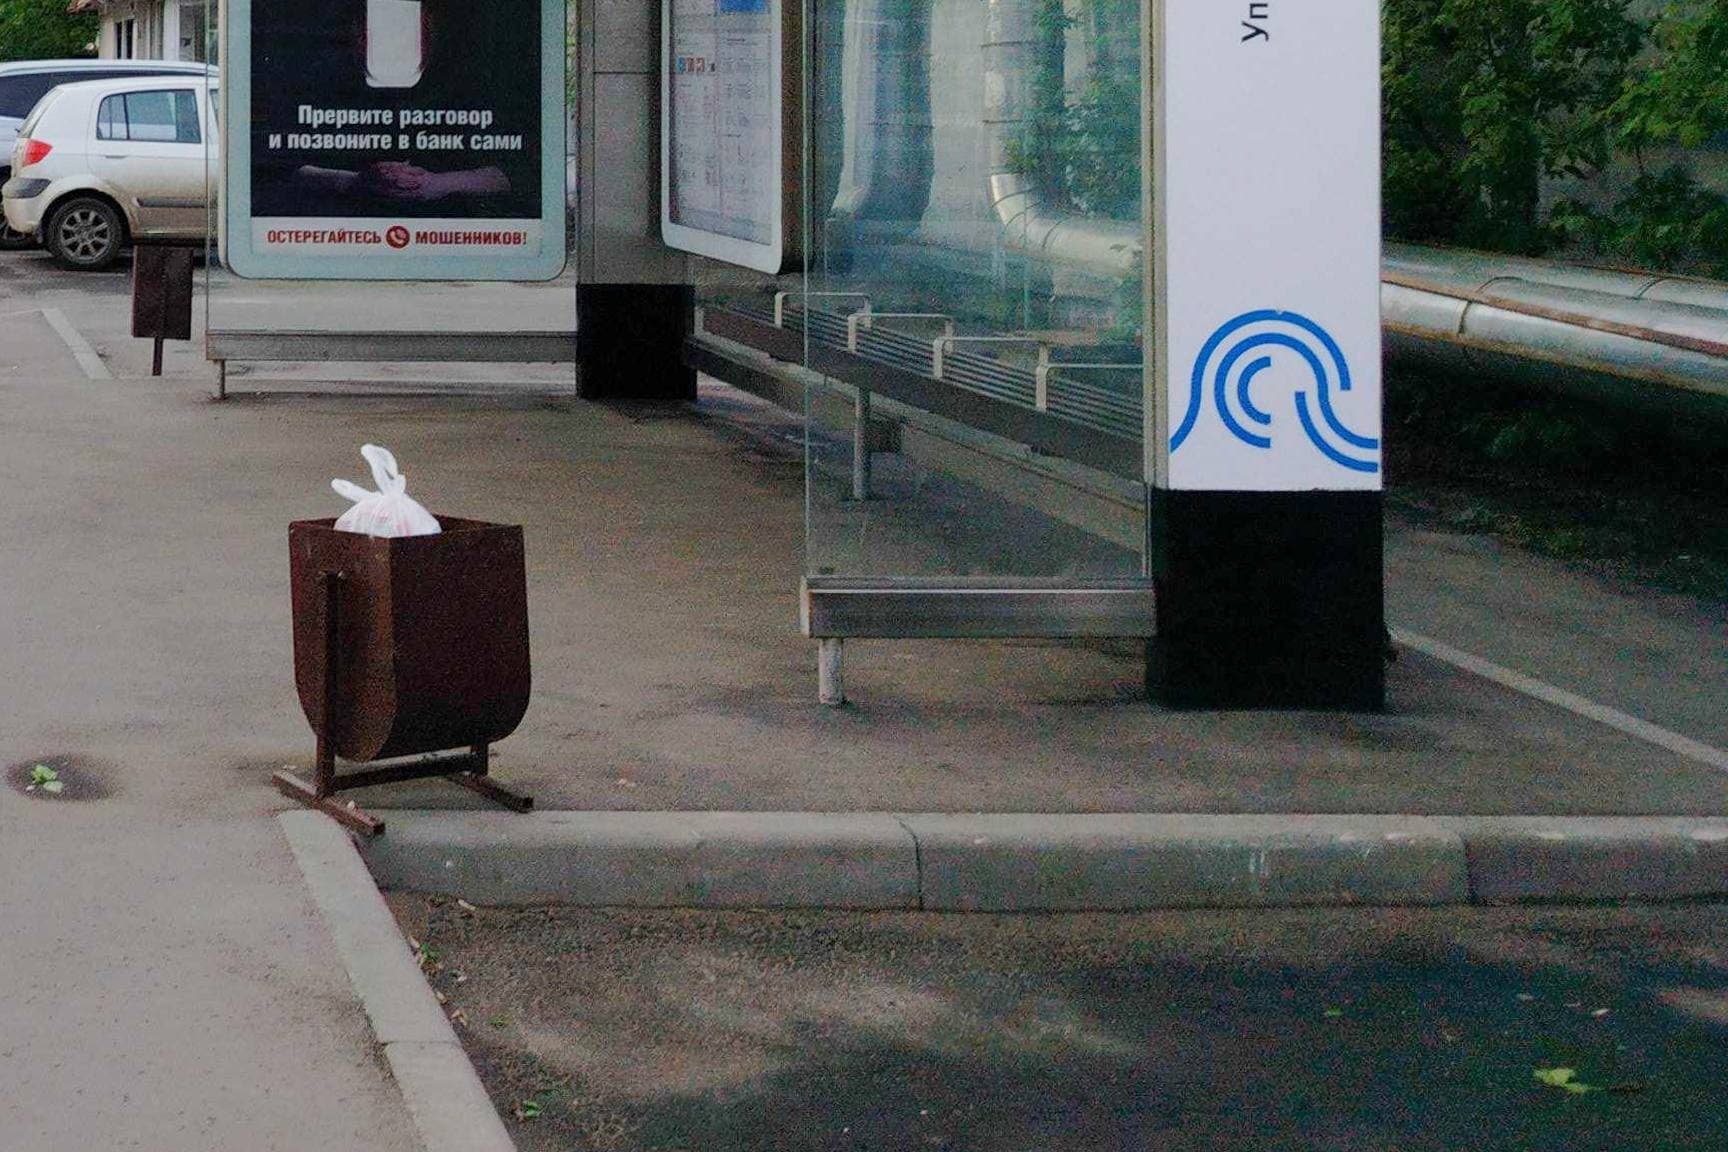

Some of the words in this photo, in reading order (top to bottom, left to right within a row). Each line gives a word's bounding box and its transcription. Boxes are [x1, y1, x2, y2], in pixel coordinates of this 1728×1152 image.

[297, 104, 394, 130] Прервите
[399, 108, 493, 130] разговор
[268, 133, 282, 149] и
[287, 133, 393, 150] позвоните
[398, 133, 410, 149] в
[416, 129, 465, 150] банк
[470, 133, 523, 150] сами
[267, 227, 383, 245] ОСТЕРЕГАЙТЕСЬ
[415, 230, 528, 246] МОШЕННИКОВ!
